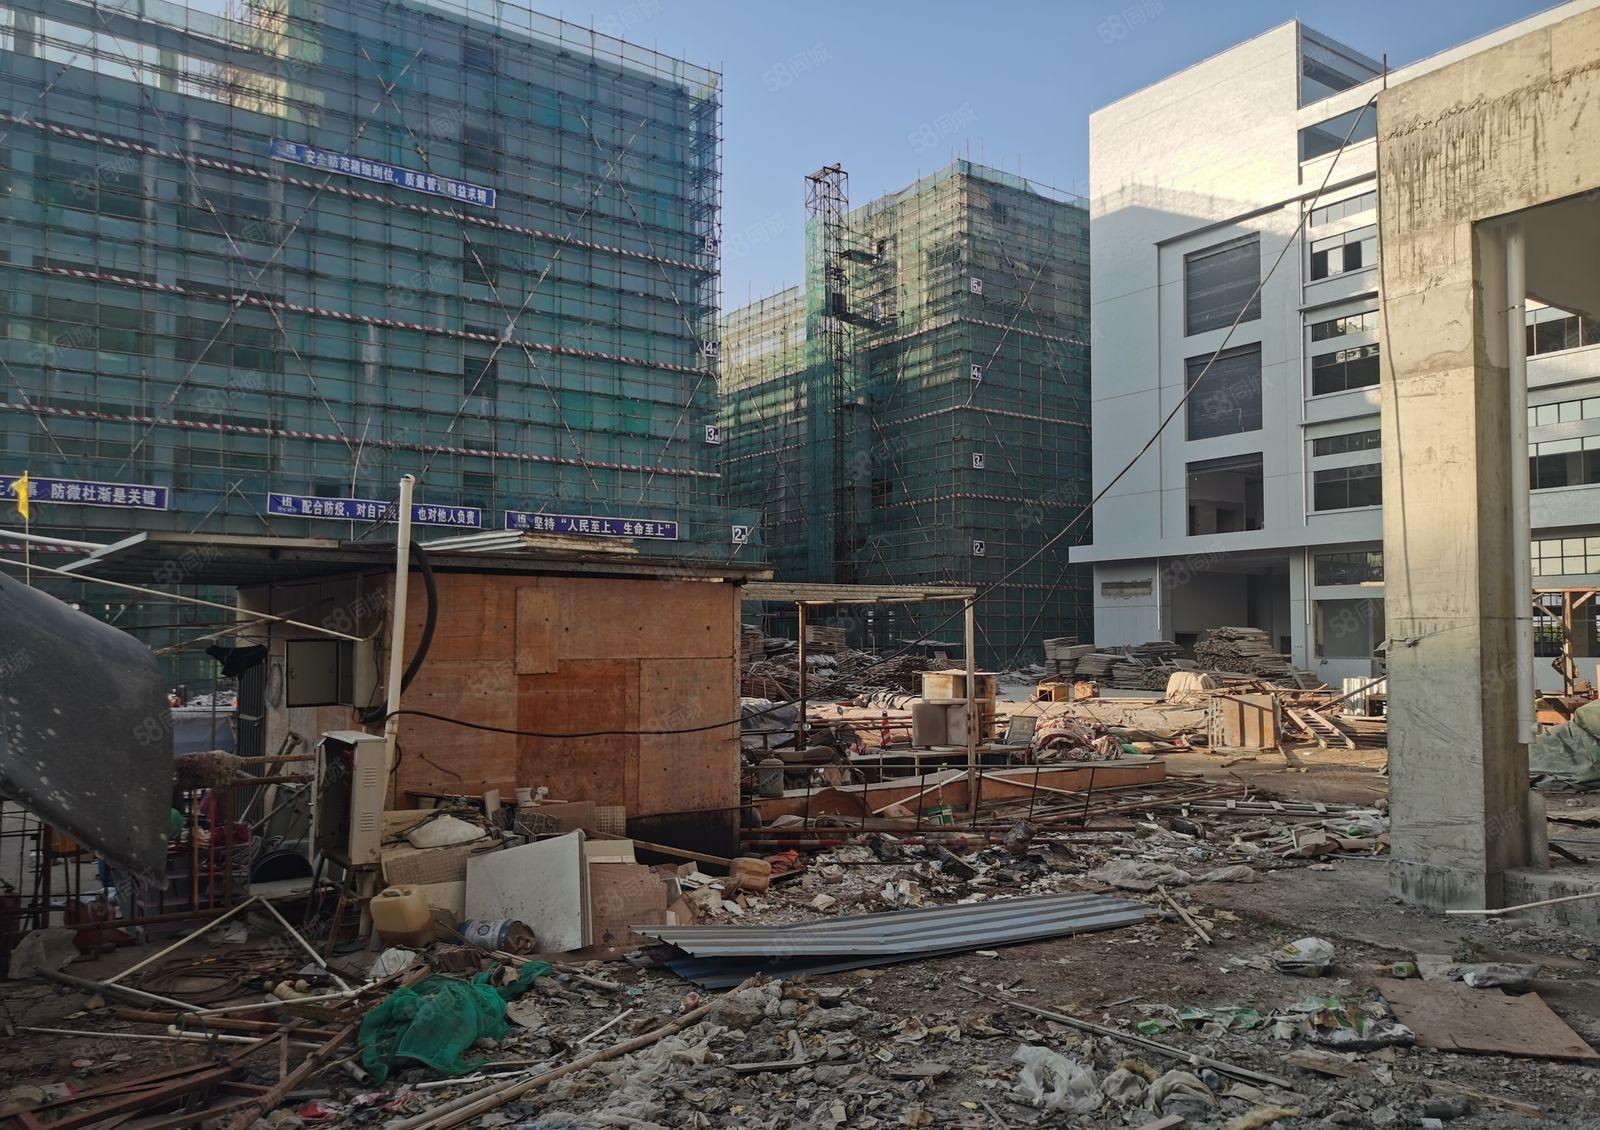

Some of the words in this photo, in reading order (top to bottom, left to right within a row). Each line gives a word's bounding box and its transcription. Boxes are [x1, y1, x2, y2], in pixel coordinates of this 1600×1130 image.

[51, 483, 157, 506] 防微杜渐是关键
